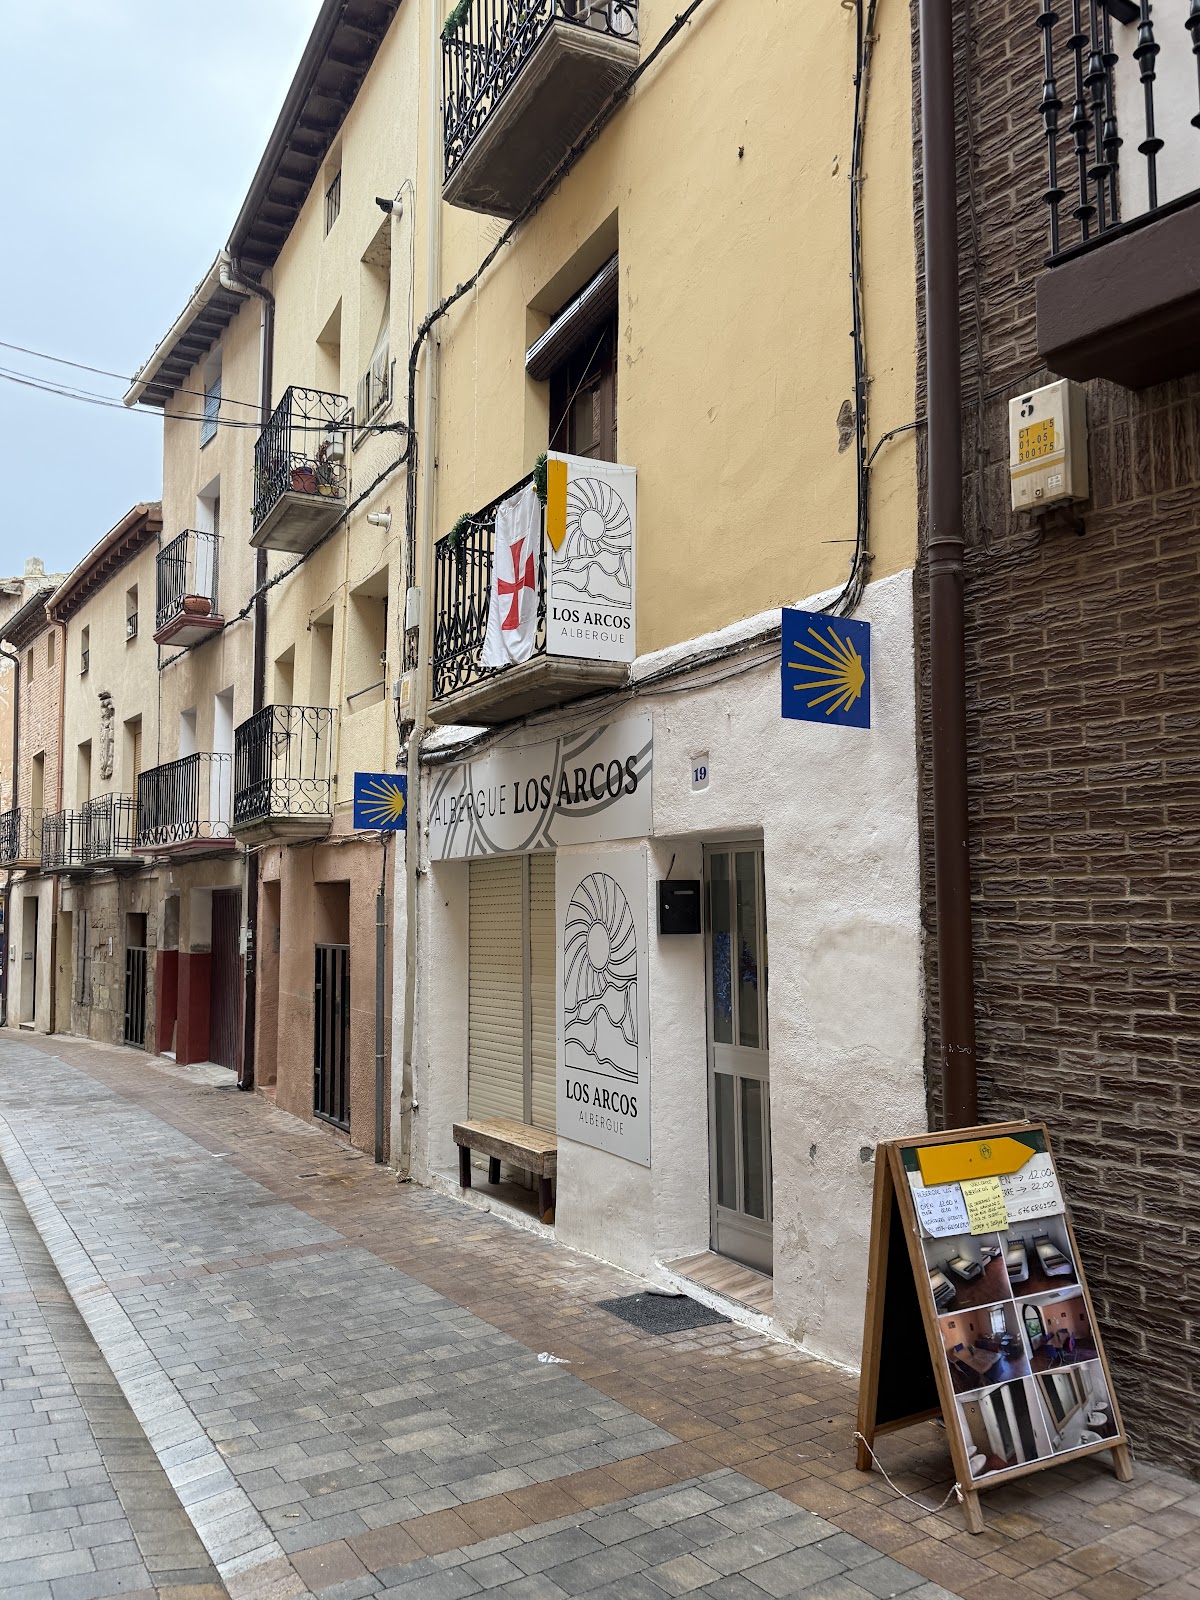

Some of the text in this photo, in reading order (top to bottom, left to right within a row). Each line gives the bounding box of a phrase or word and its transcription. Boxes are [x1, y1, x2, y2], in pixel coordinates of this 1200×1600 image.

[1019, 428, 1030, 439] CT
[1019, 432, 1048, 450] 01-05
[1019, 441, 1054, 462] 300175
[553, 607, 631, 629] LOS ARCOS
[561, 627, 625, 643] ALBERGUE
[693, 766, 707, 782] 19
[434, 755, 638, 827] ALBERGUE LOS ARCOS
[566, 1079, 638, 1118] LOS ARCOS
[579, 1110, 624, 1136] ALBERGUE
